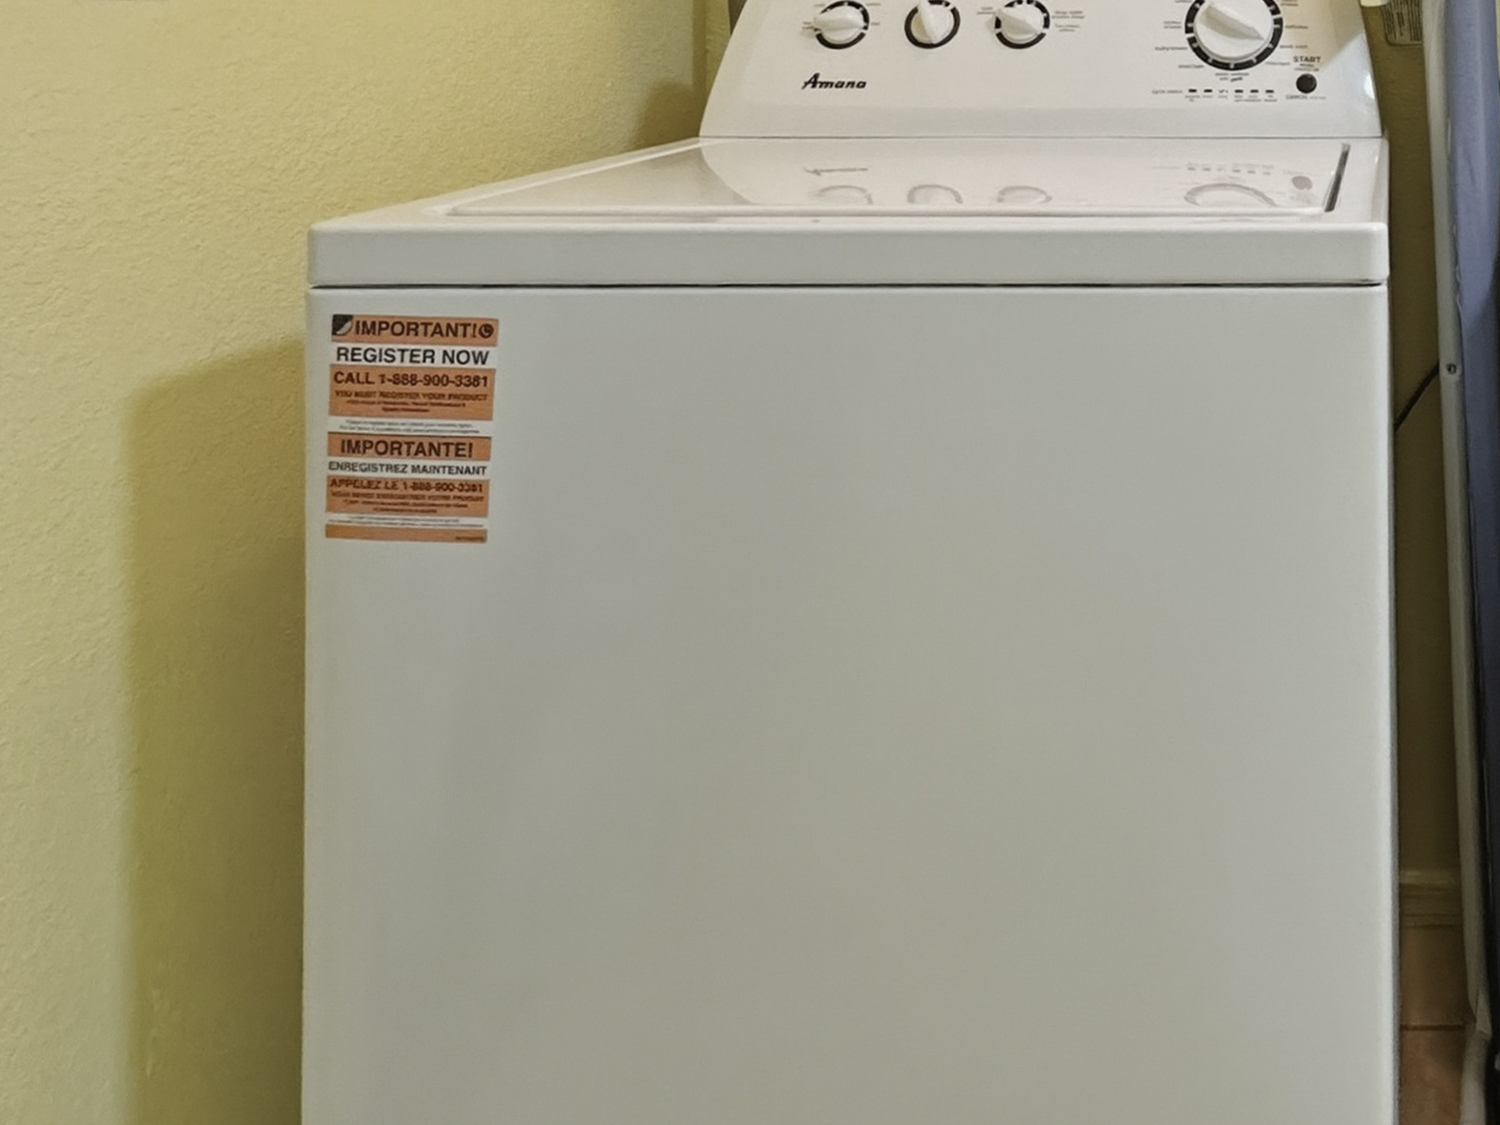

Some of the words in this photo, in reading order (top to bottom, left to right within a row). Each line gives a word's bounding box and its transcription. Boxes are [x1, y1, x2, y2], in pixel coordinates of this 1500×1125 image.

[1293, 55, 1322, 63] START
[801, 72, 867, 90] Amana
[355, 320, 477, 339] IMPORTANT!
[336, 346, 435, 364] REGISTER
[441, 349, 490, 365] NOW
[333, 370, 375, 385] CALL
[379, 373, 488, 388] 1-888-900-3381
[340, 438, 473, 459] IMPORTANTE!
[328, 461, 409, 474] ENREGISTREZ
[410, 464, 488, 476] MAINTENANT
[330, 478, 382, 490] APPELEZ
[384, 479, 399, 491] LE
